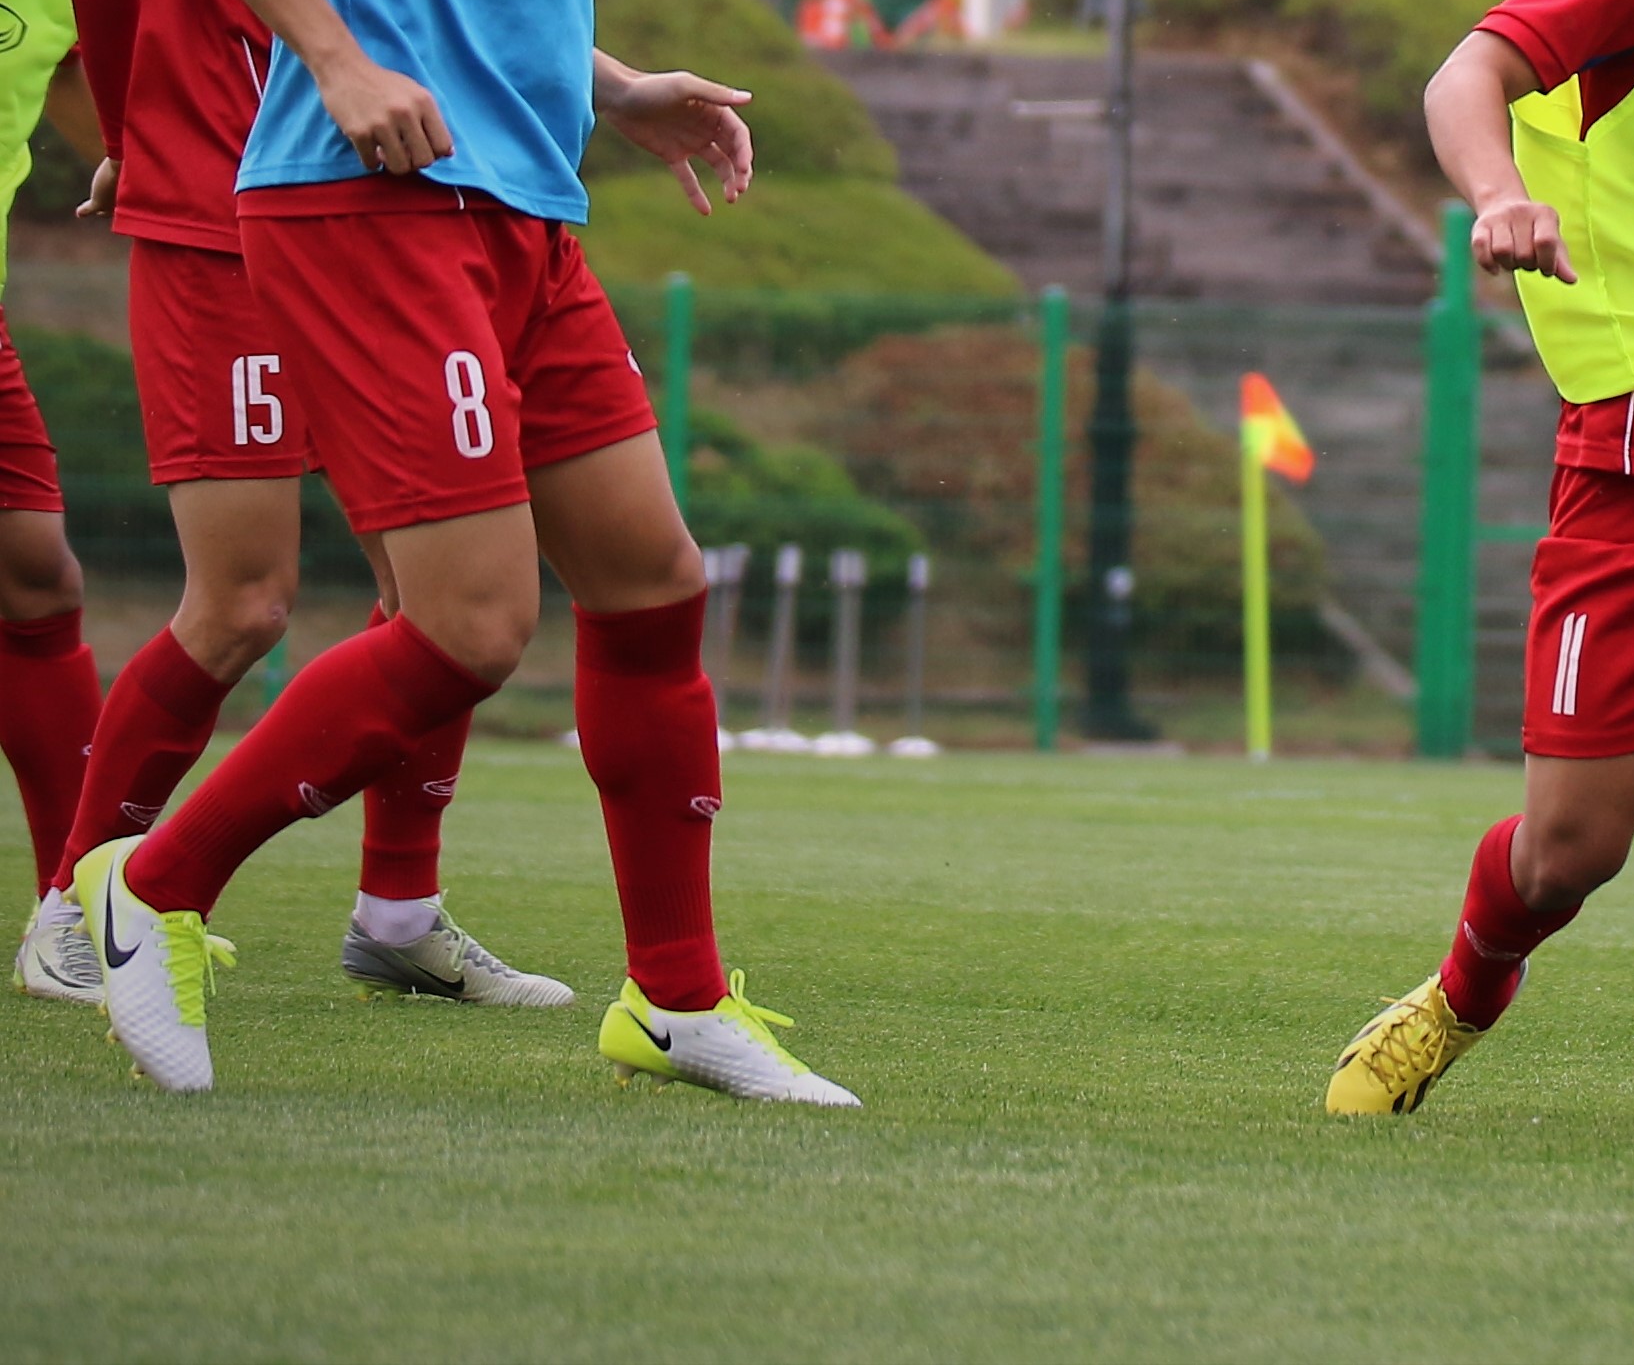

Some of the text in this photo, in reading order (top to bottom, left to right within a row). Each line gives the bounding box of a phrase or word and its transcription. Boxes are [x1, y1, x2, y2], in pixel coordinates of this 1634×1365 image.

[231, 354, 283, 445] 15
[444, 350, 494, 459] 8
[1552, 612, 1587, 716] 11
